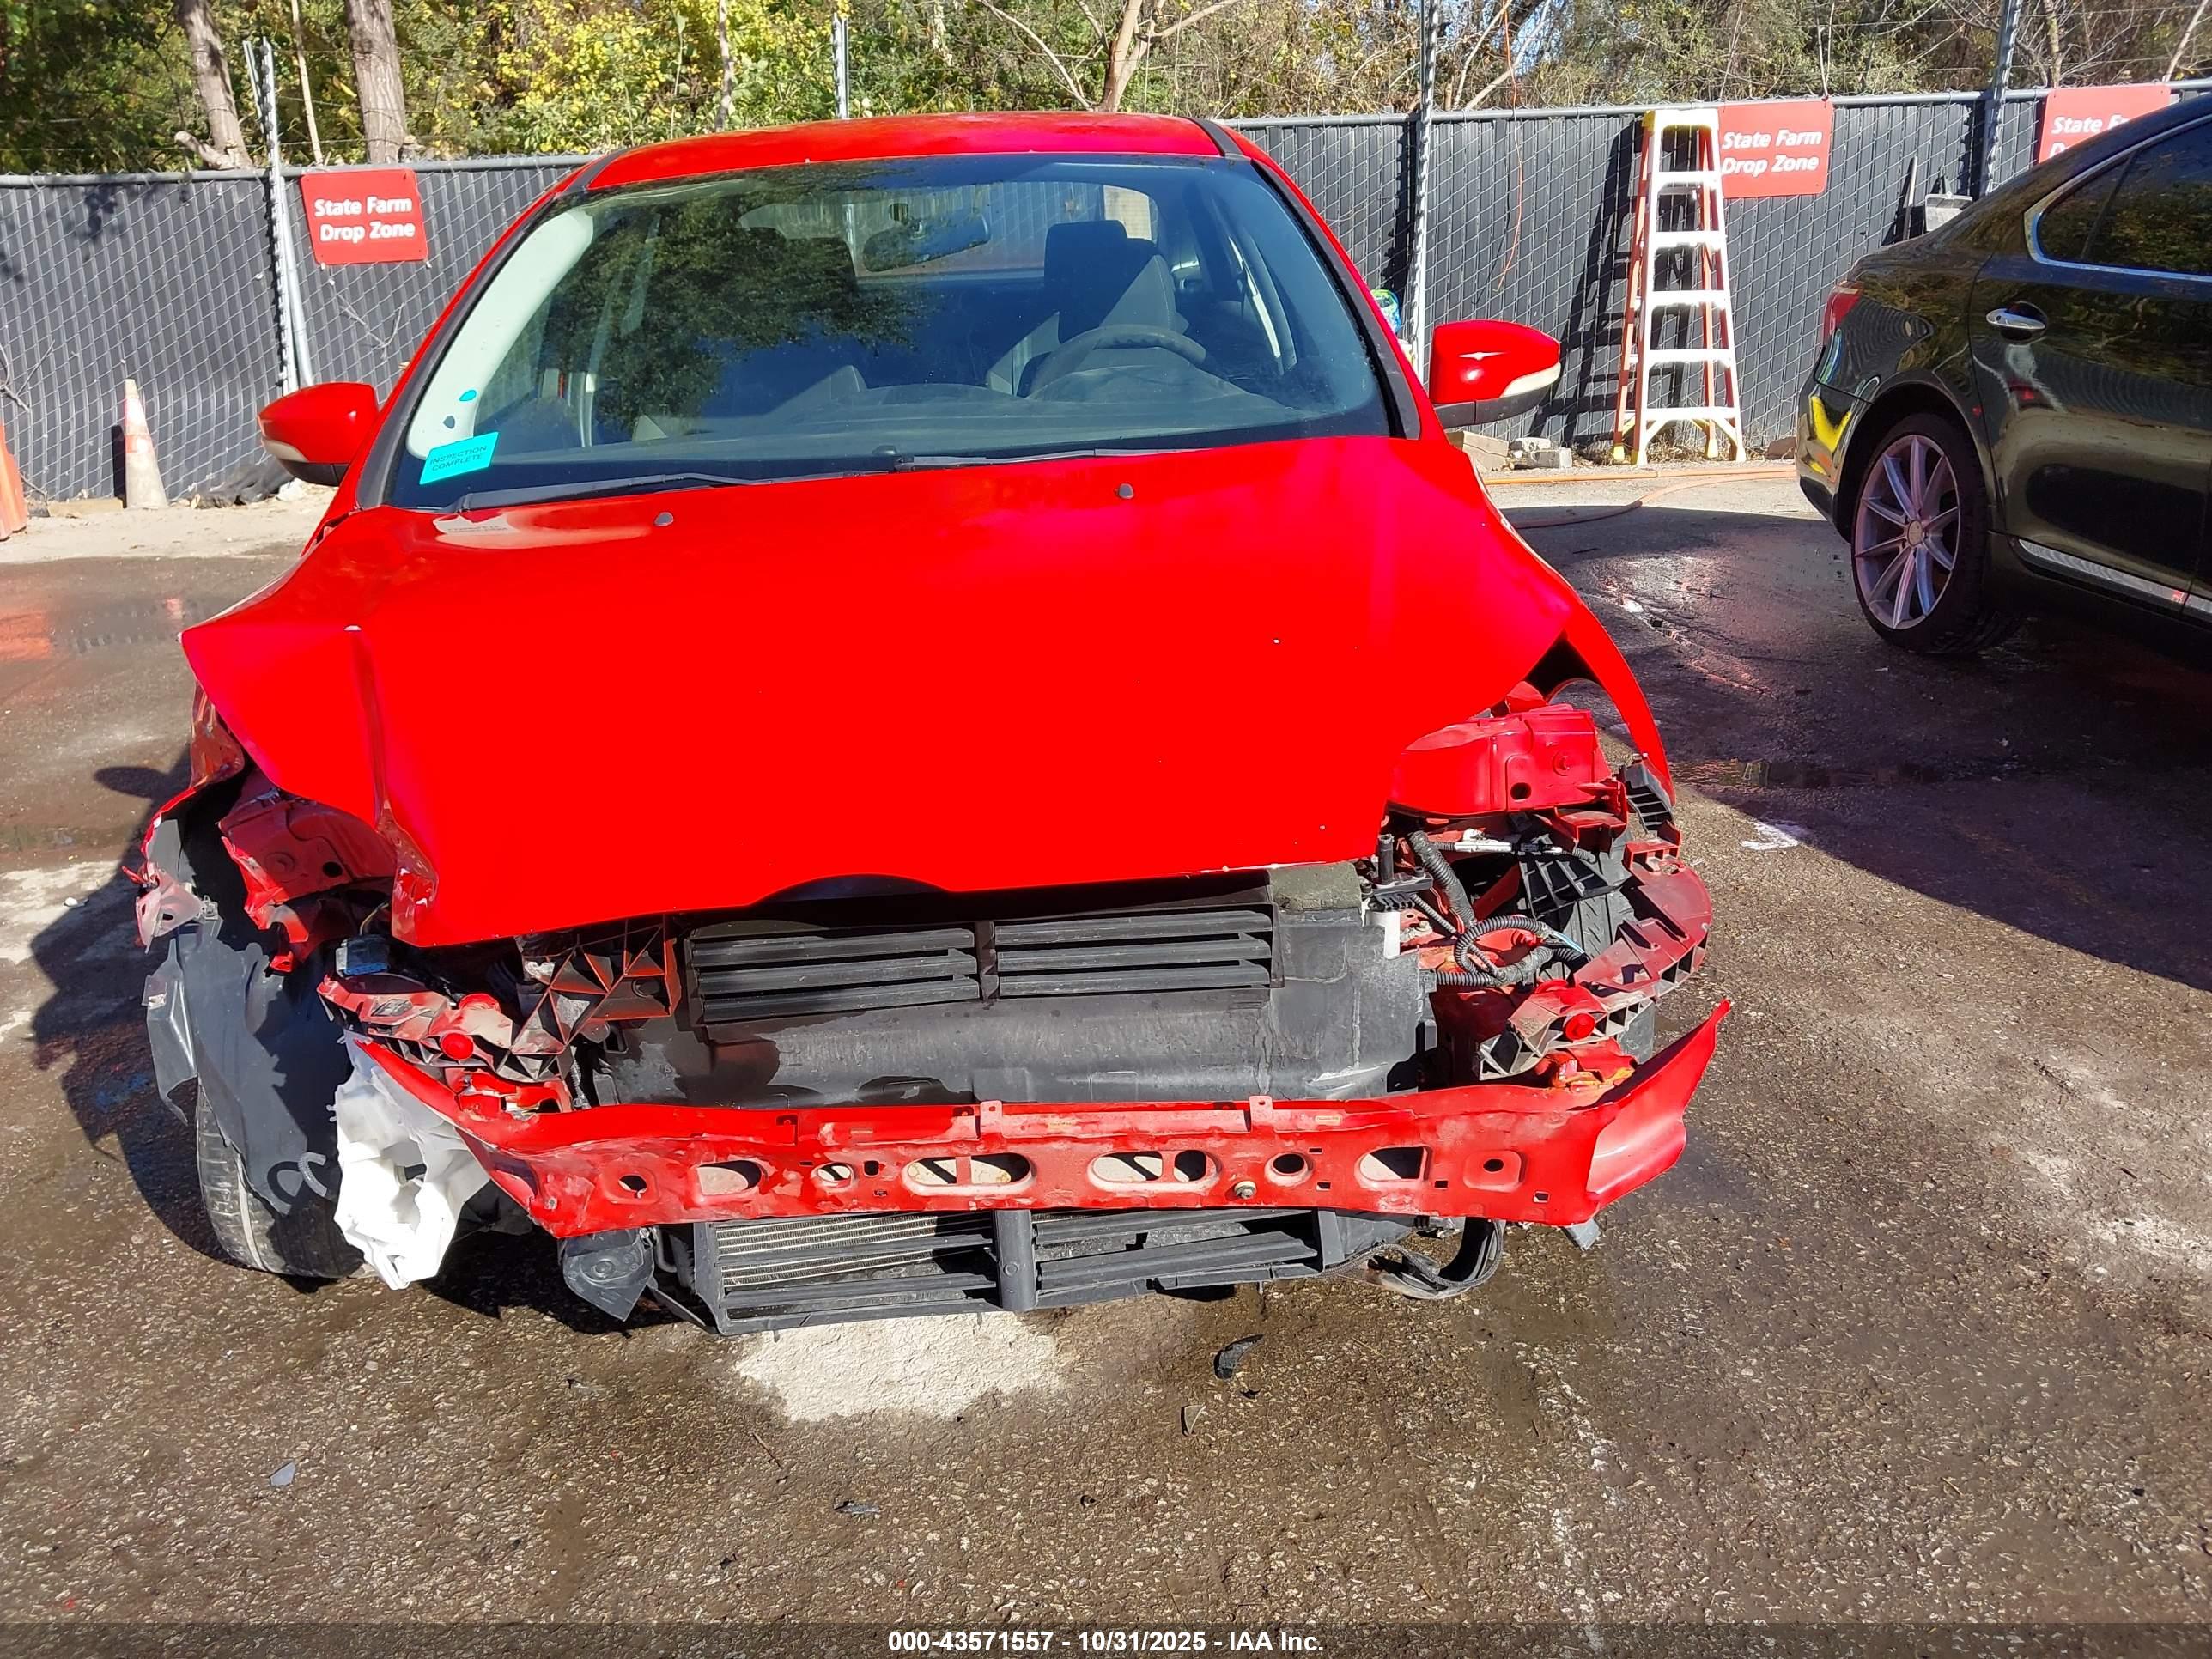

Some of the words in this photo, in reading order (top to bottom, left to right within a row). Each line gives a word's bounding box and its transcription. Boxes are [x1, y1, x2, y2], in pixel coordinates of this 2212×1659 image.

[2051, 116, 2103, 135] State
[1722, 131, 1771, 149] State
[1776, 130, 1823, 147] Farm
[1722, 157, 1768, 177] Drop
[1771, 155, 1820, 173] Zone
[314, 198, 362, 217] State
[366, 196, 412, 214] Farm
[319, 223, 365, 244] Drop
[369, 221, 416, 239] Zone
[430, 446, 488, 465] INSPECTION
[432, 453, 482, 471] COMPLETE
